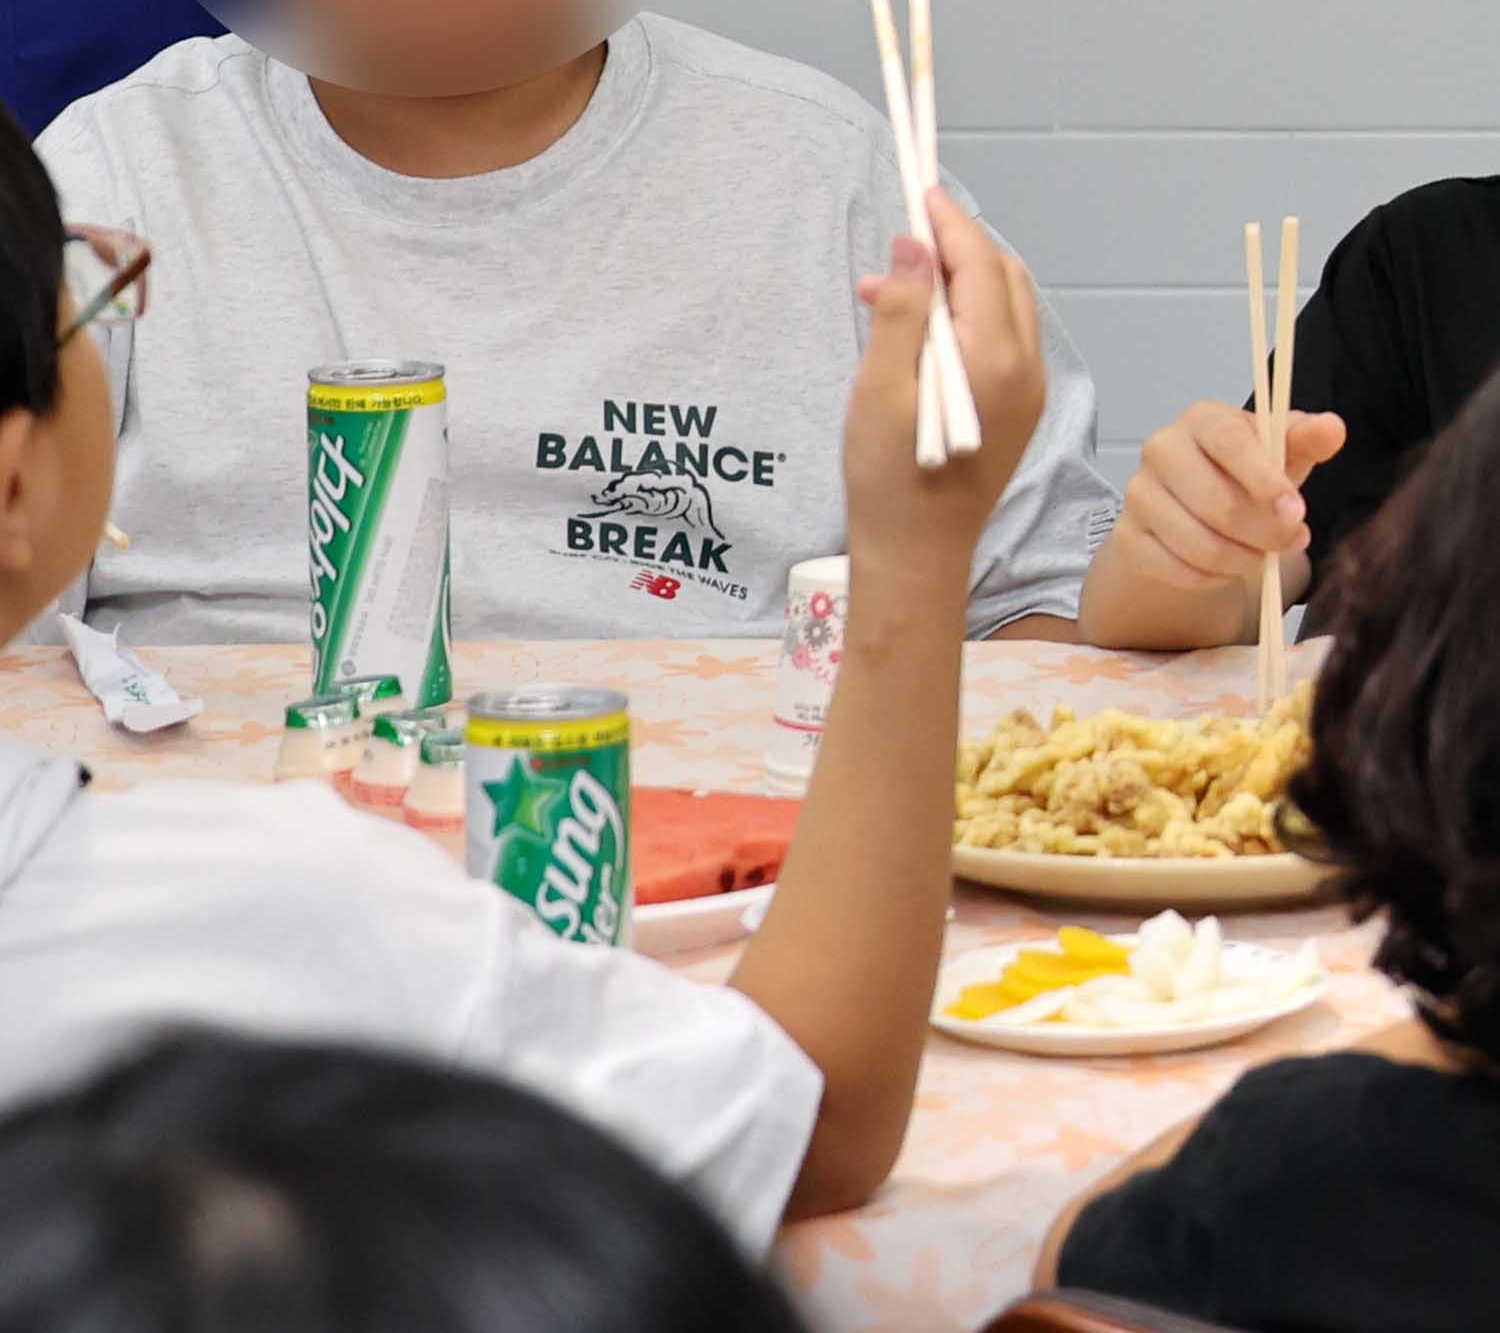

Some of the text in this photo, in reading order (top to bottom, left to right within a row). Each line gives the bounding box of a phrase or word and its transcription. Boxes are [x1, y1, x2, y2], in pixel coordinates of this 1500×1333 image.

[604, 400, 717, 438] NEW
[536, 433, 774, 486] BALANCE
[567, 518, 733, 574] BREAK
[698, 574, 749, 601] WAVES
[536, 769, 626, 939] sung
